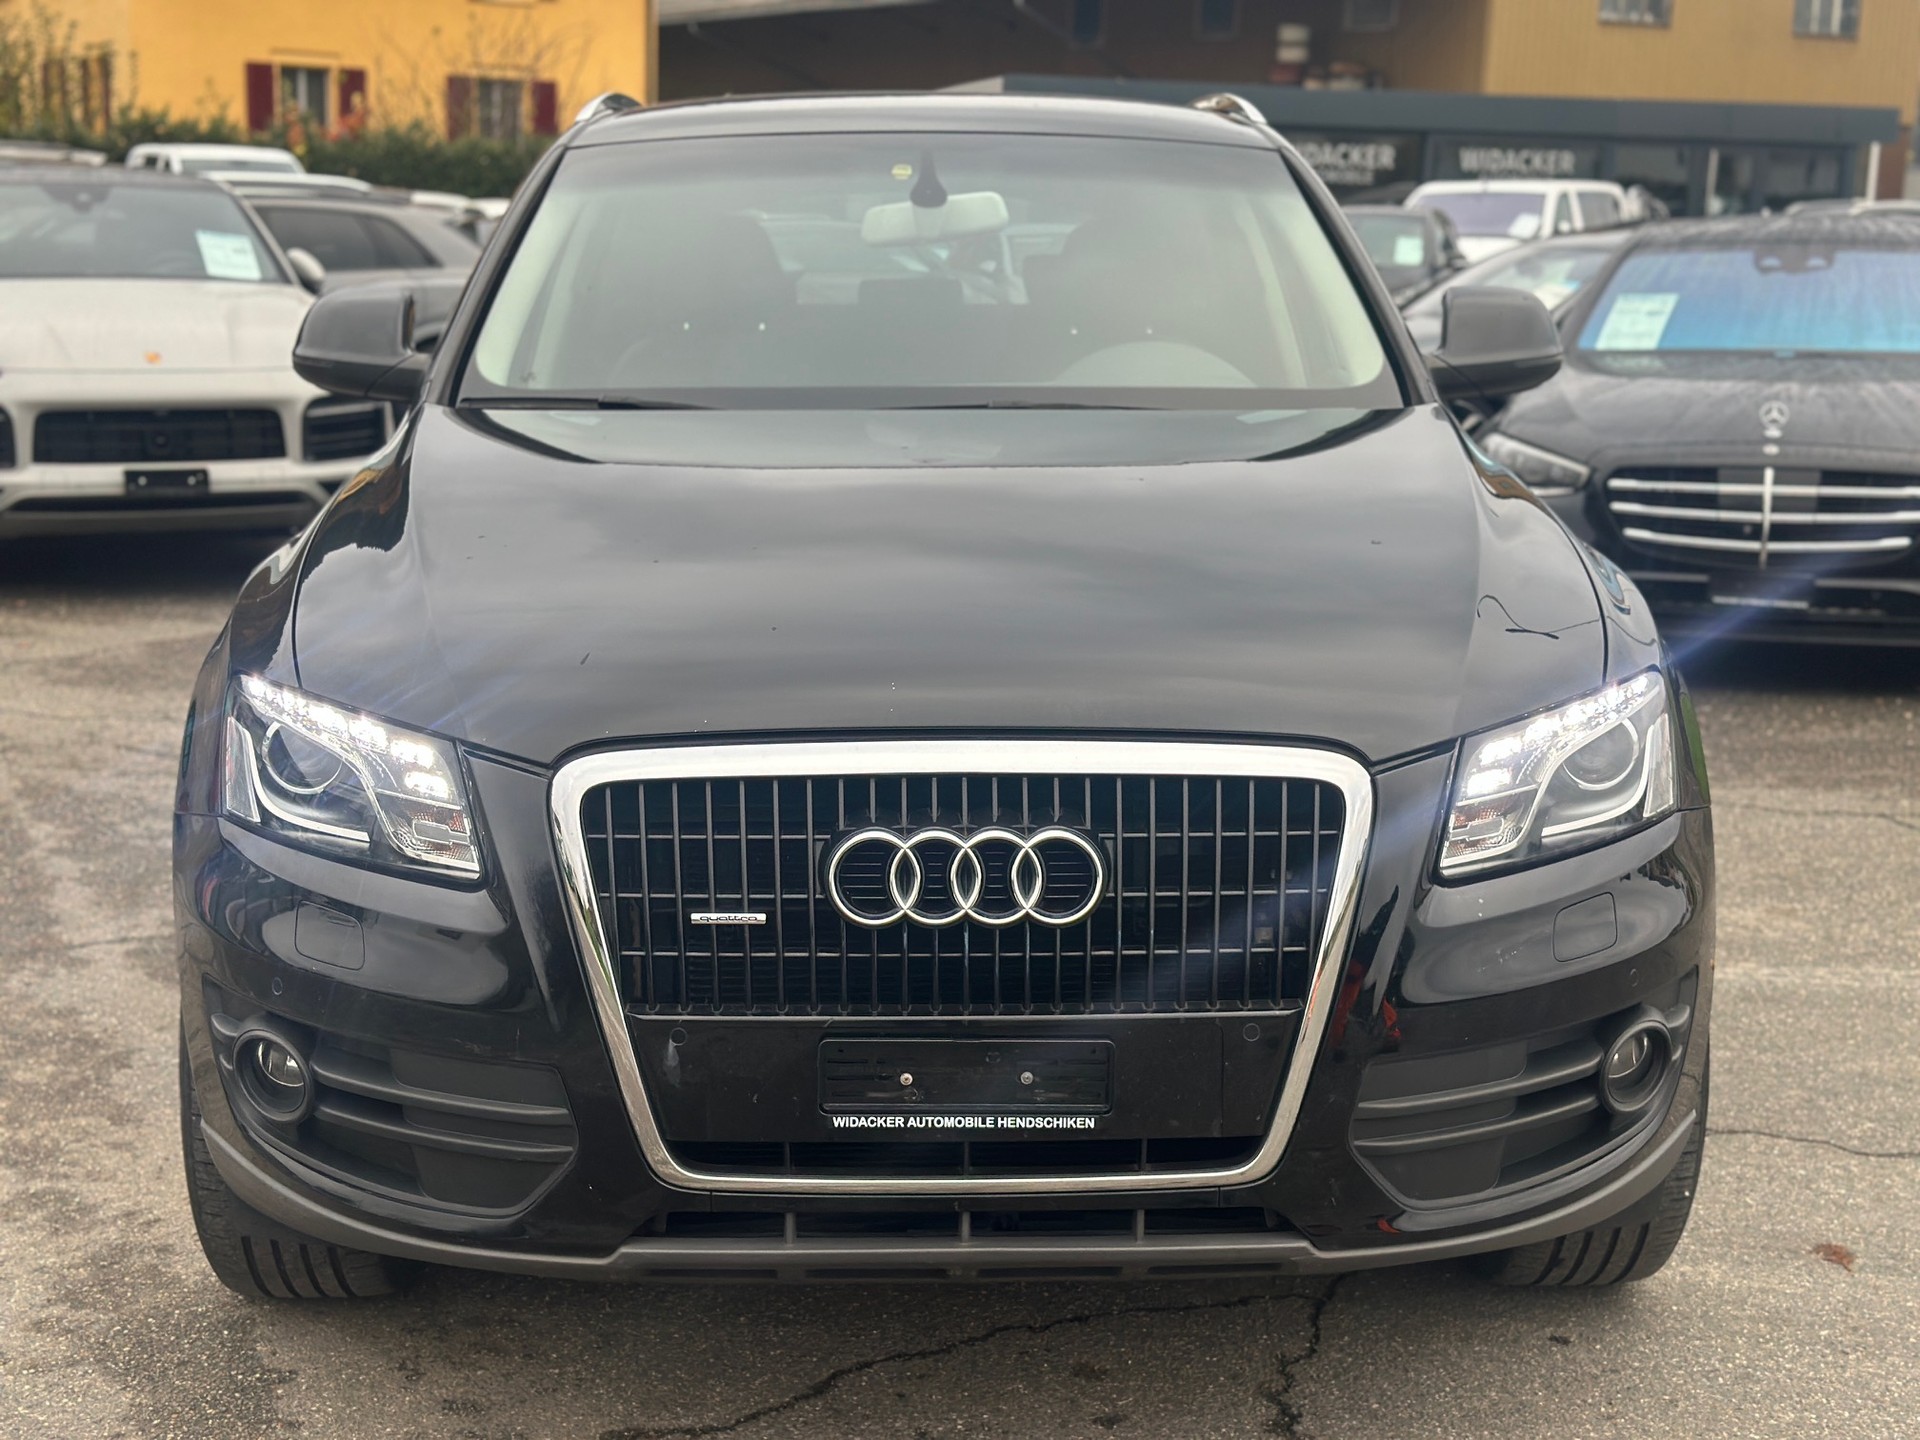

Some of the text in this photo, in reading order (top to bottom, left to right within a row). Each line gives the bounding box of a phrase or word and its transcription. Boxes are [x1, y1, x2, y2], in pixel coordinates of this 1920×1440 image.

[1459, 147, 1575, 174] WIDACKER
[832, 1116, 1095, 1129] WIDACKER AUTOMOBILE HENDSCHIKEN
